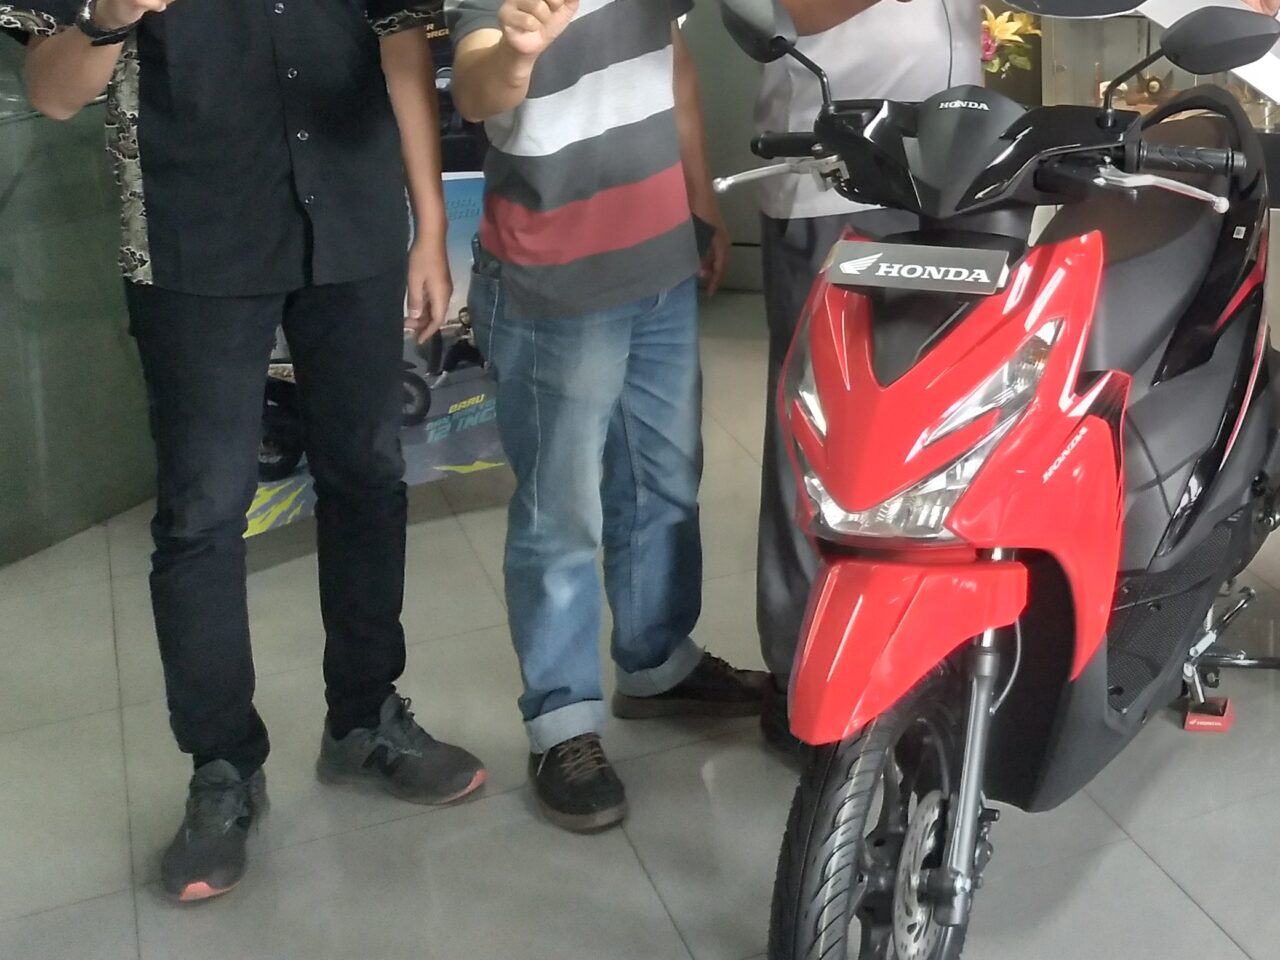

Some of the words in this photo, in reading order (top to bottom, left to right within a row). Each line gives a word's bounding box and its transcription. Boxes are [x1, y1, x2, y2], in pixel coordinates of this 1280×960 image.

[939, 100, 990, 110] HONDA
[875, 262, 991, 283] HONDA
[1043, 427, 1088, 483] HONDA
